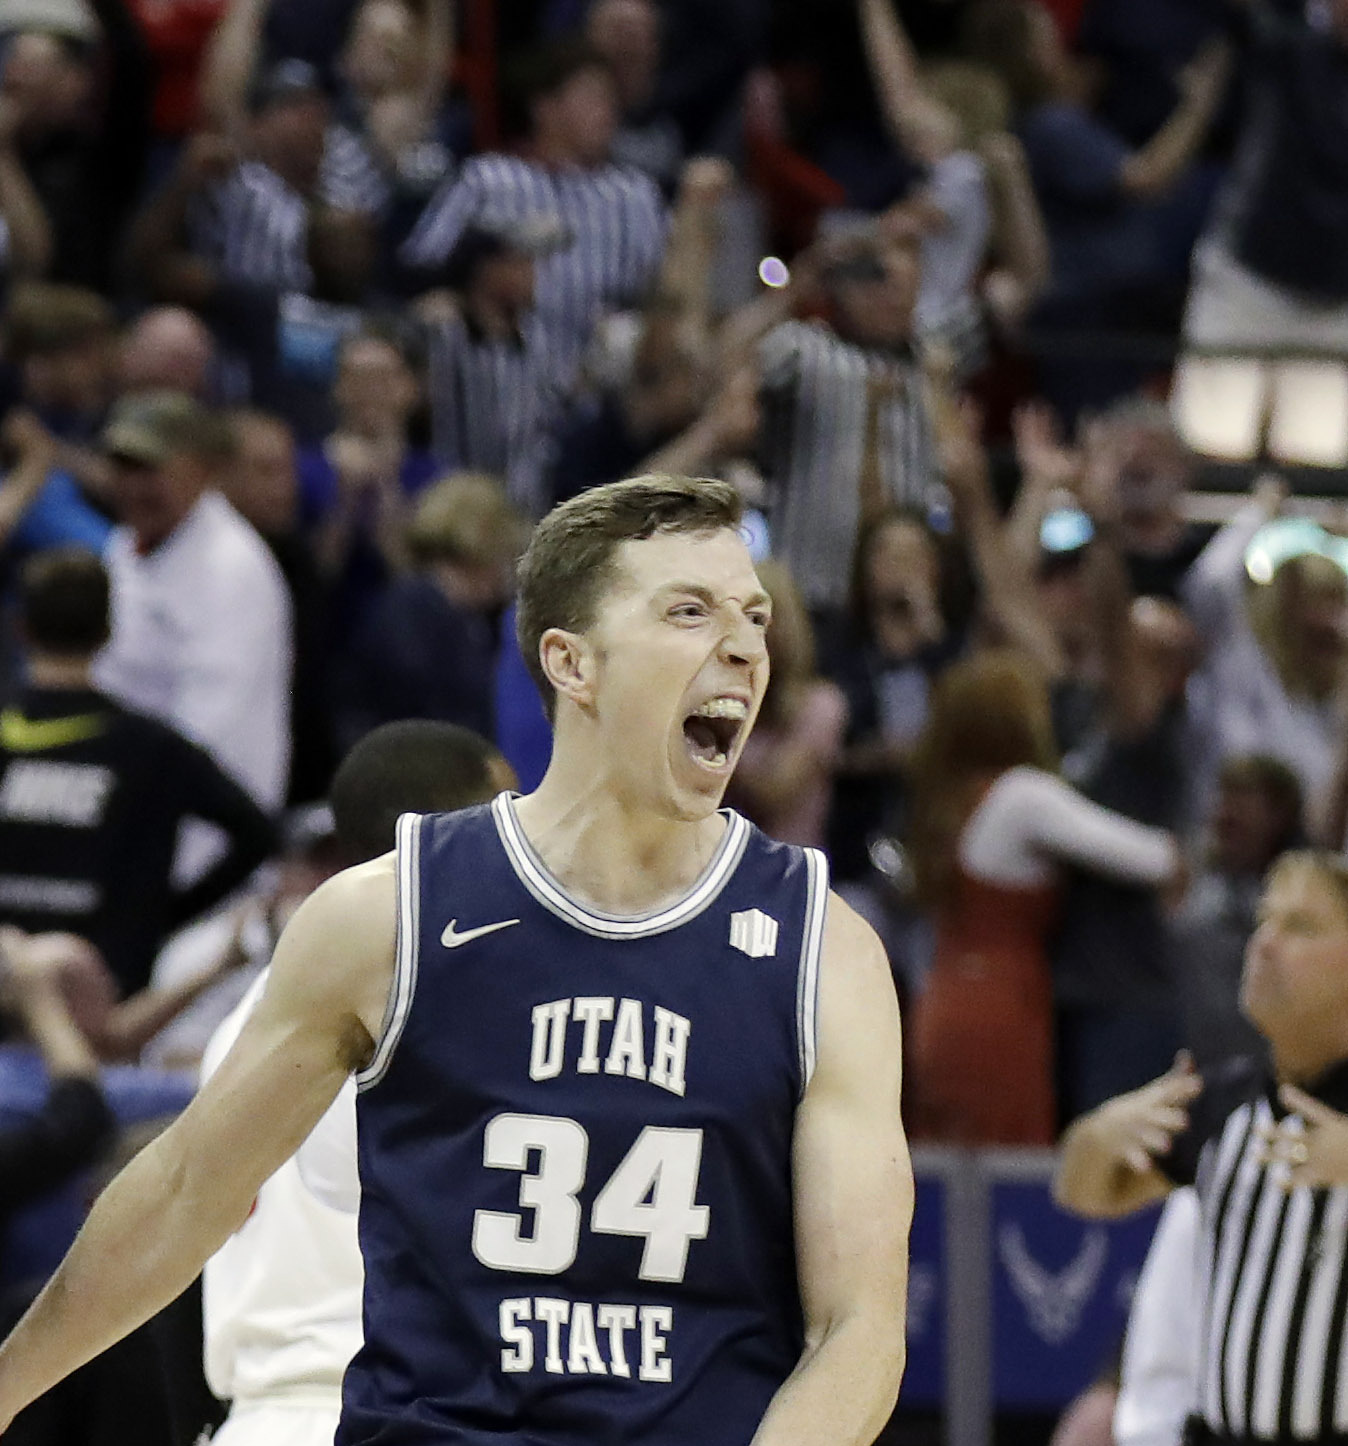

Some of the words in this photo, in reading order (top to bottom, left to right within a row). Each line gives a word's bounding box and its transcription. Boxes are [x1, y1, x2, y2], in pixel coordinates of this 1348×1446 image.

[529, 996, 692, 1097] UTAH
[471, 1112, 711, 1283] 34
[499, 1296, 674, 1382] STATE
